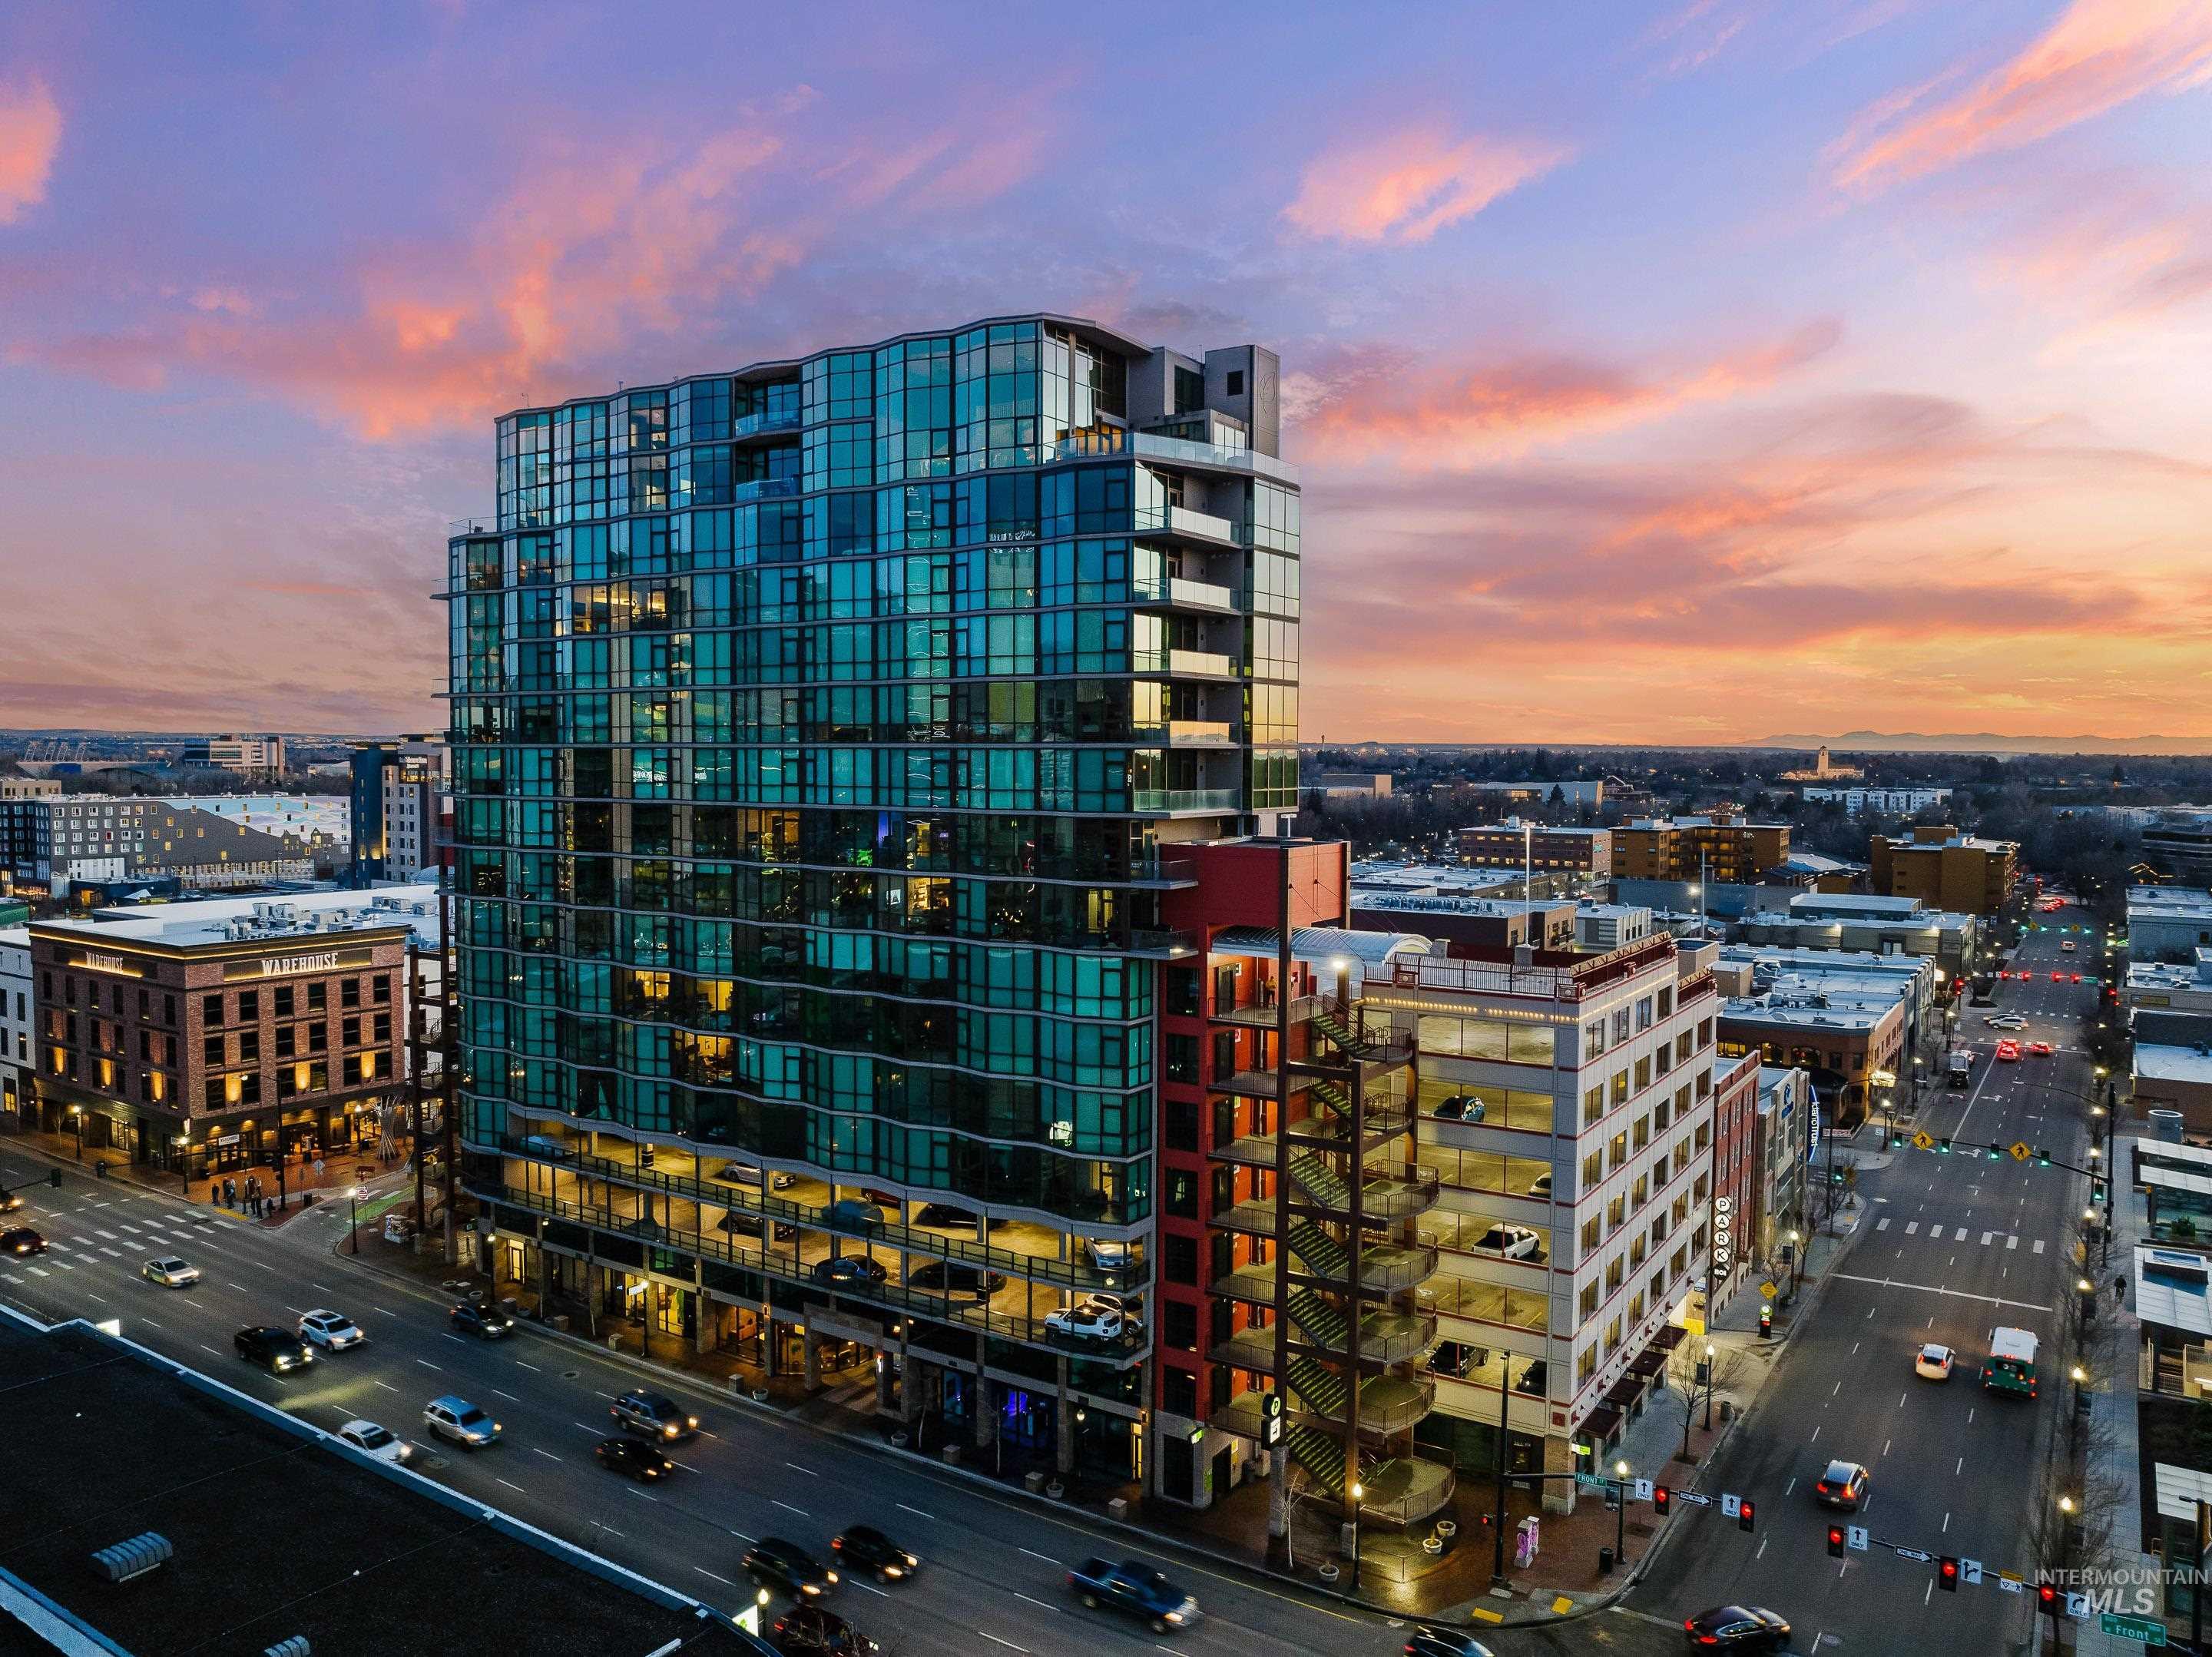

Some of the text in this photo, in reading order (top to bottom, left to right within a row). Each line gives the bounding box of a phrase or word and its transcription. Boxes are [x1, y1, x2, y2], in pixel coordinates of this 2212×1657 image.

[85, 951, 124, 975] WAREHOUSE
[261, 952, 339, 977] WAREHOUSE
[1717, 1200, 1727, 1261] PARK
[1578, 1473, 1598, 1484] FRONT
[2115, 1625, 2150, 1642] Front
